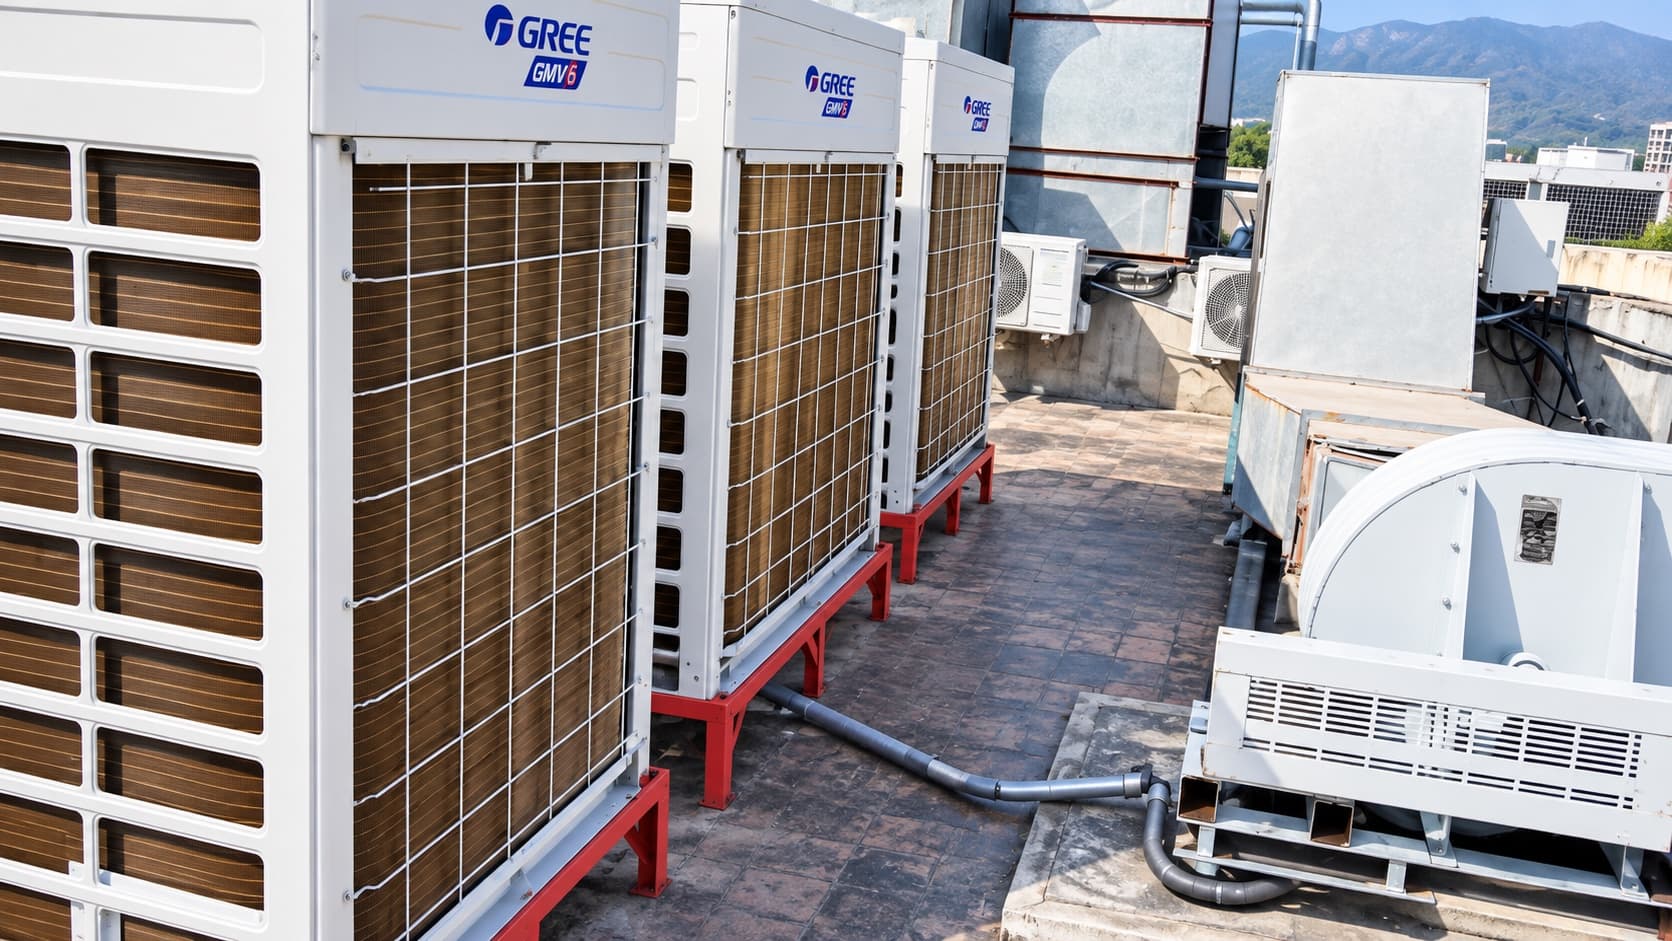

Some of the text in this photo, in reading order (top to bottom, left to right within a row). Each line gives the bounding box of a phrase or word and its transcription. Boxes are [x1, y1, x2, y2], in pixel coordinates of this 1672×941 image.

[518, 16, 592, 56] GREE
[532, 62, 578, 86] GMV6
[820, 72, 856, 97] GREE
[972, 100, 991, 116] GREE
